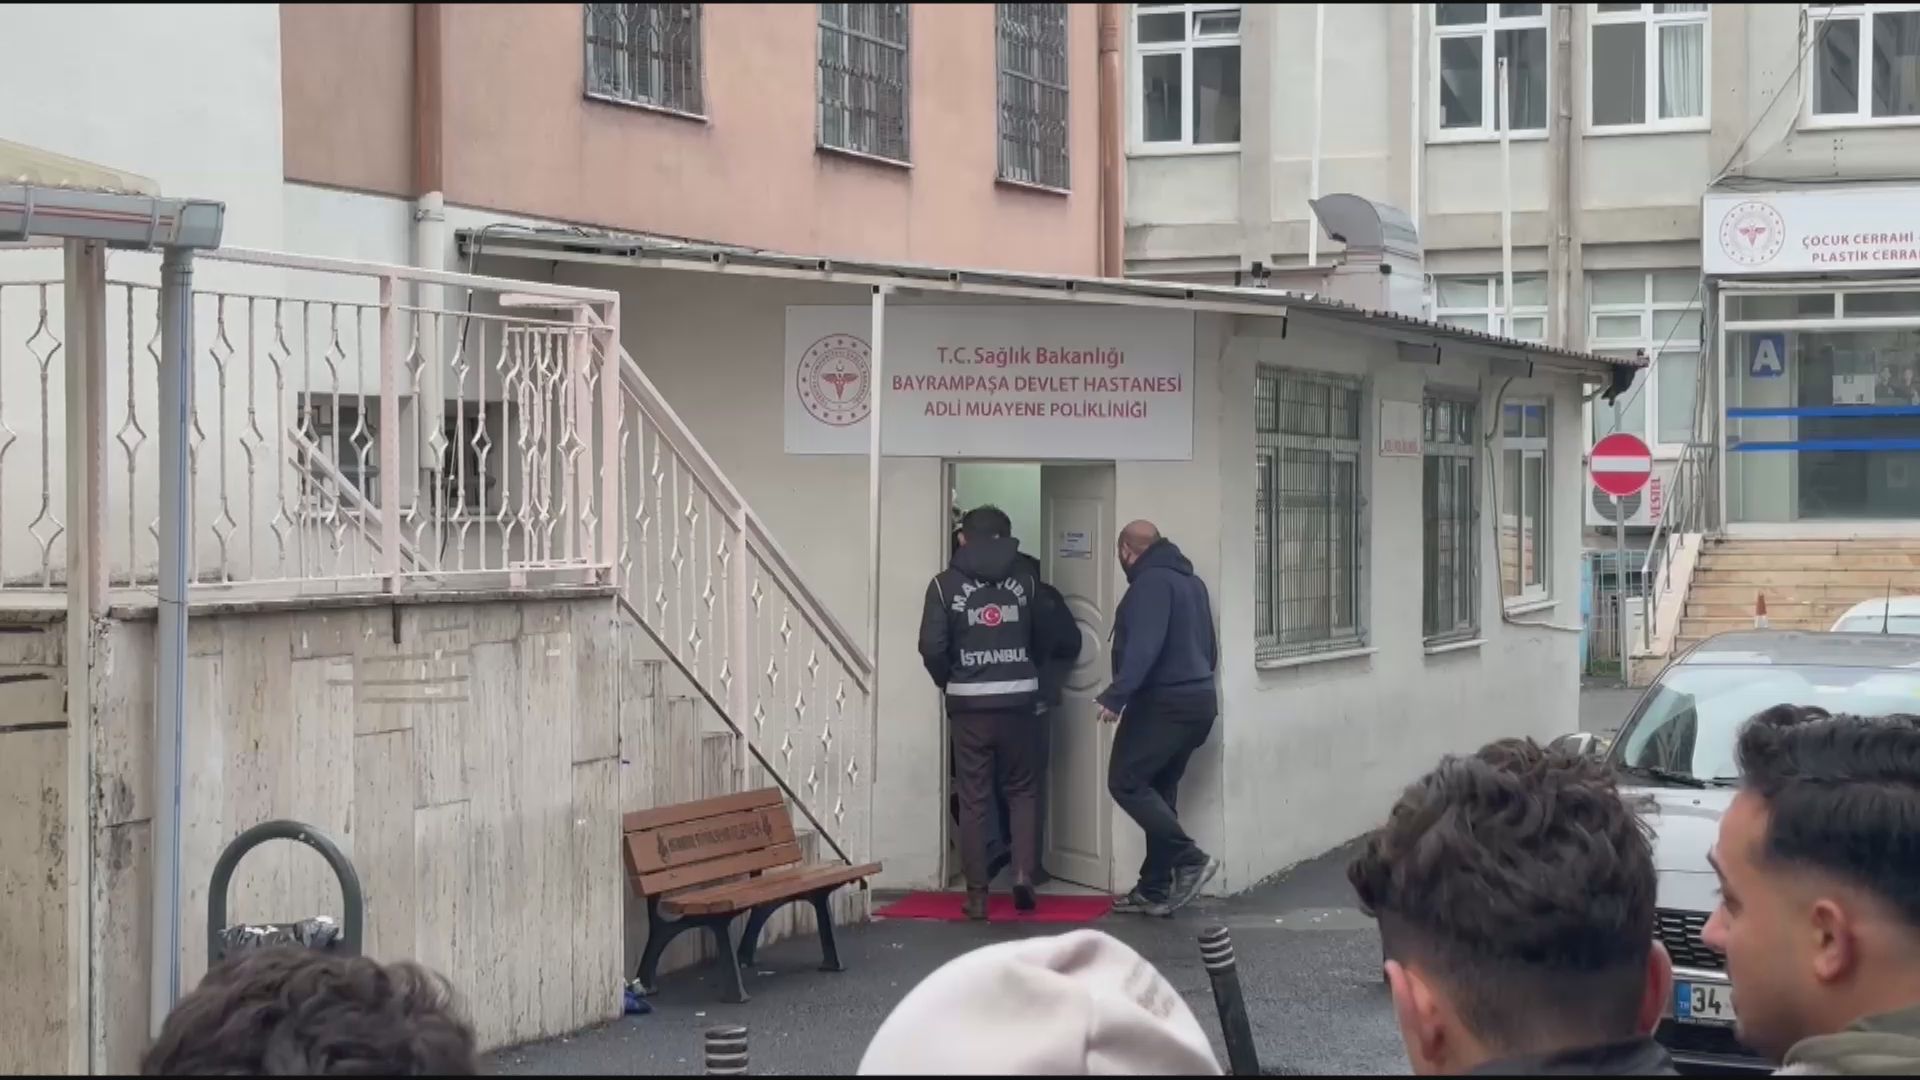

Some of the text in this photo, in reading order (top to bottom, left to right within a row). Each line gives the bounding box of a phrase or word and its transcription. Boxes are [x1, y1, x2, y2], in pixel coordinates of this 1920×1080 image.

[1802, 234, 1849, 249] ÇOCUK
[1853, 231, 1914, 244] CERRAHİ
[1812, 248, 1920, 262] PLASTİK CERRA
[1036, 346, 1125, 368] Bakanlığı
[1751, 338, 1782, 372] A
[892, 373, 1182, 395] BAYRAMPAŞA DEVLET HASTANESİ
[924, 398, 1147, 418] ADLİ MUAYENE POLİKLİNİĞİ
[1650, 477, 1661, 518] VESTEL
[960, 647, 1029, 666] İSTANBUL
[1692, 987, 1722, 1014] 34
